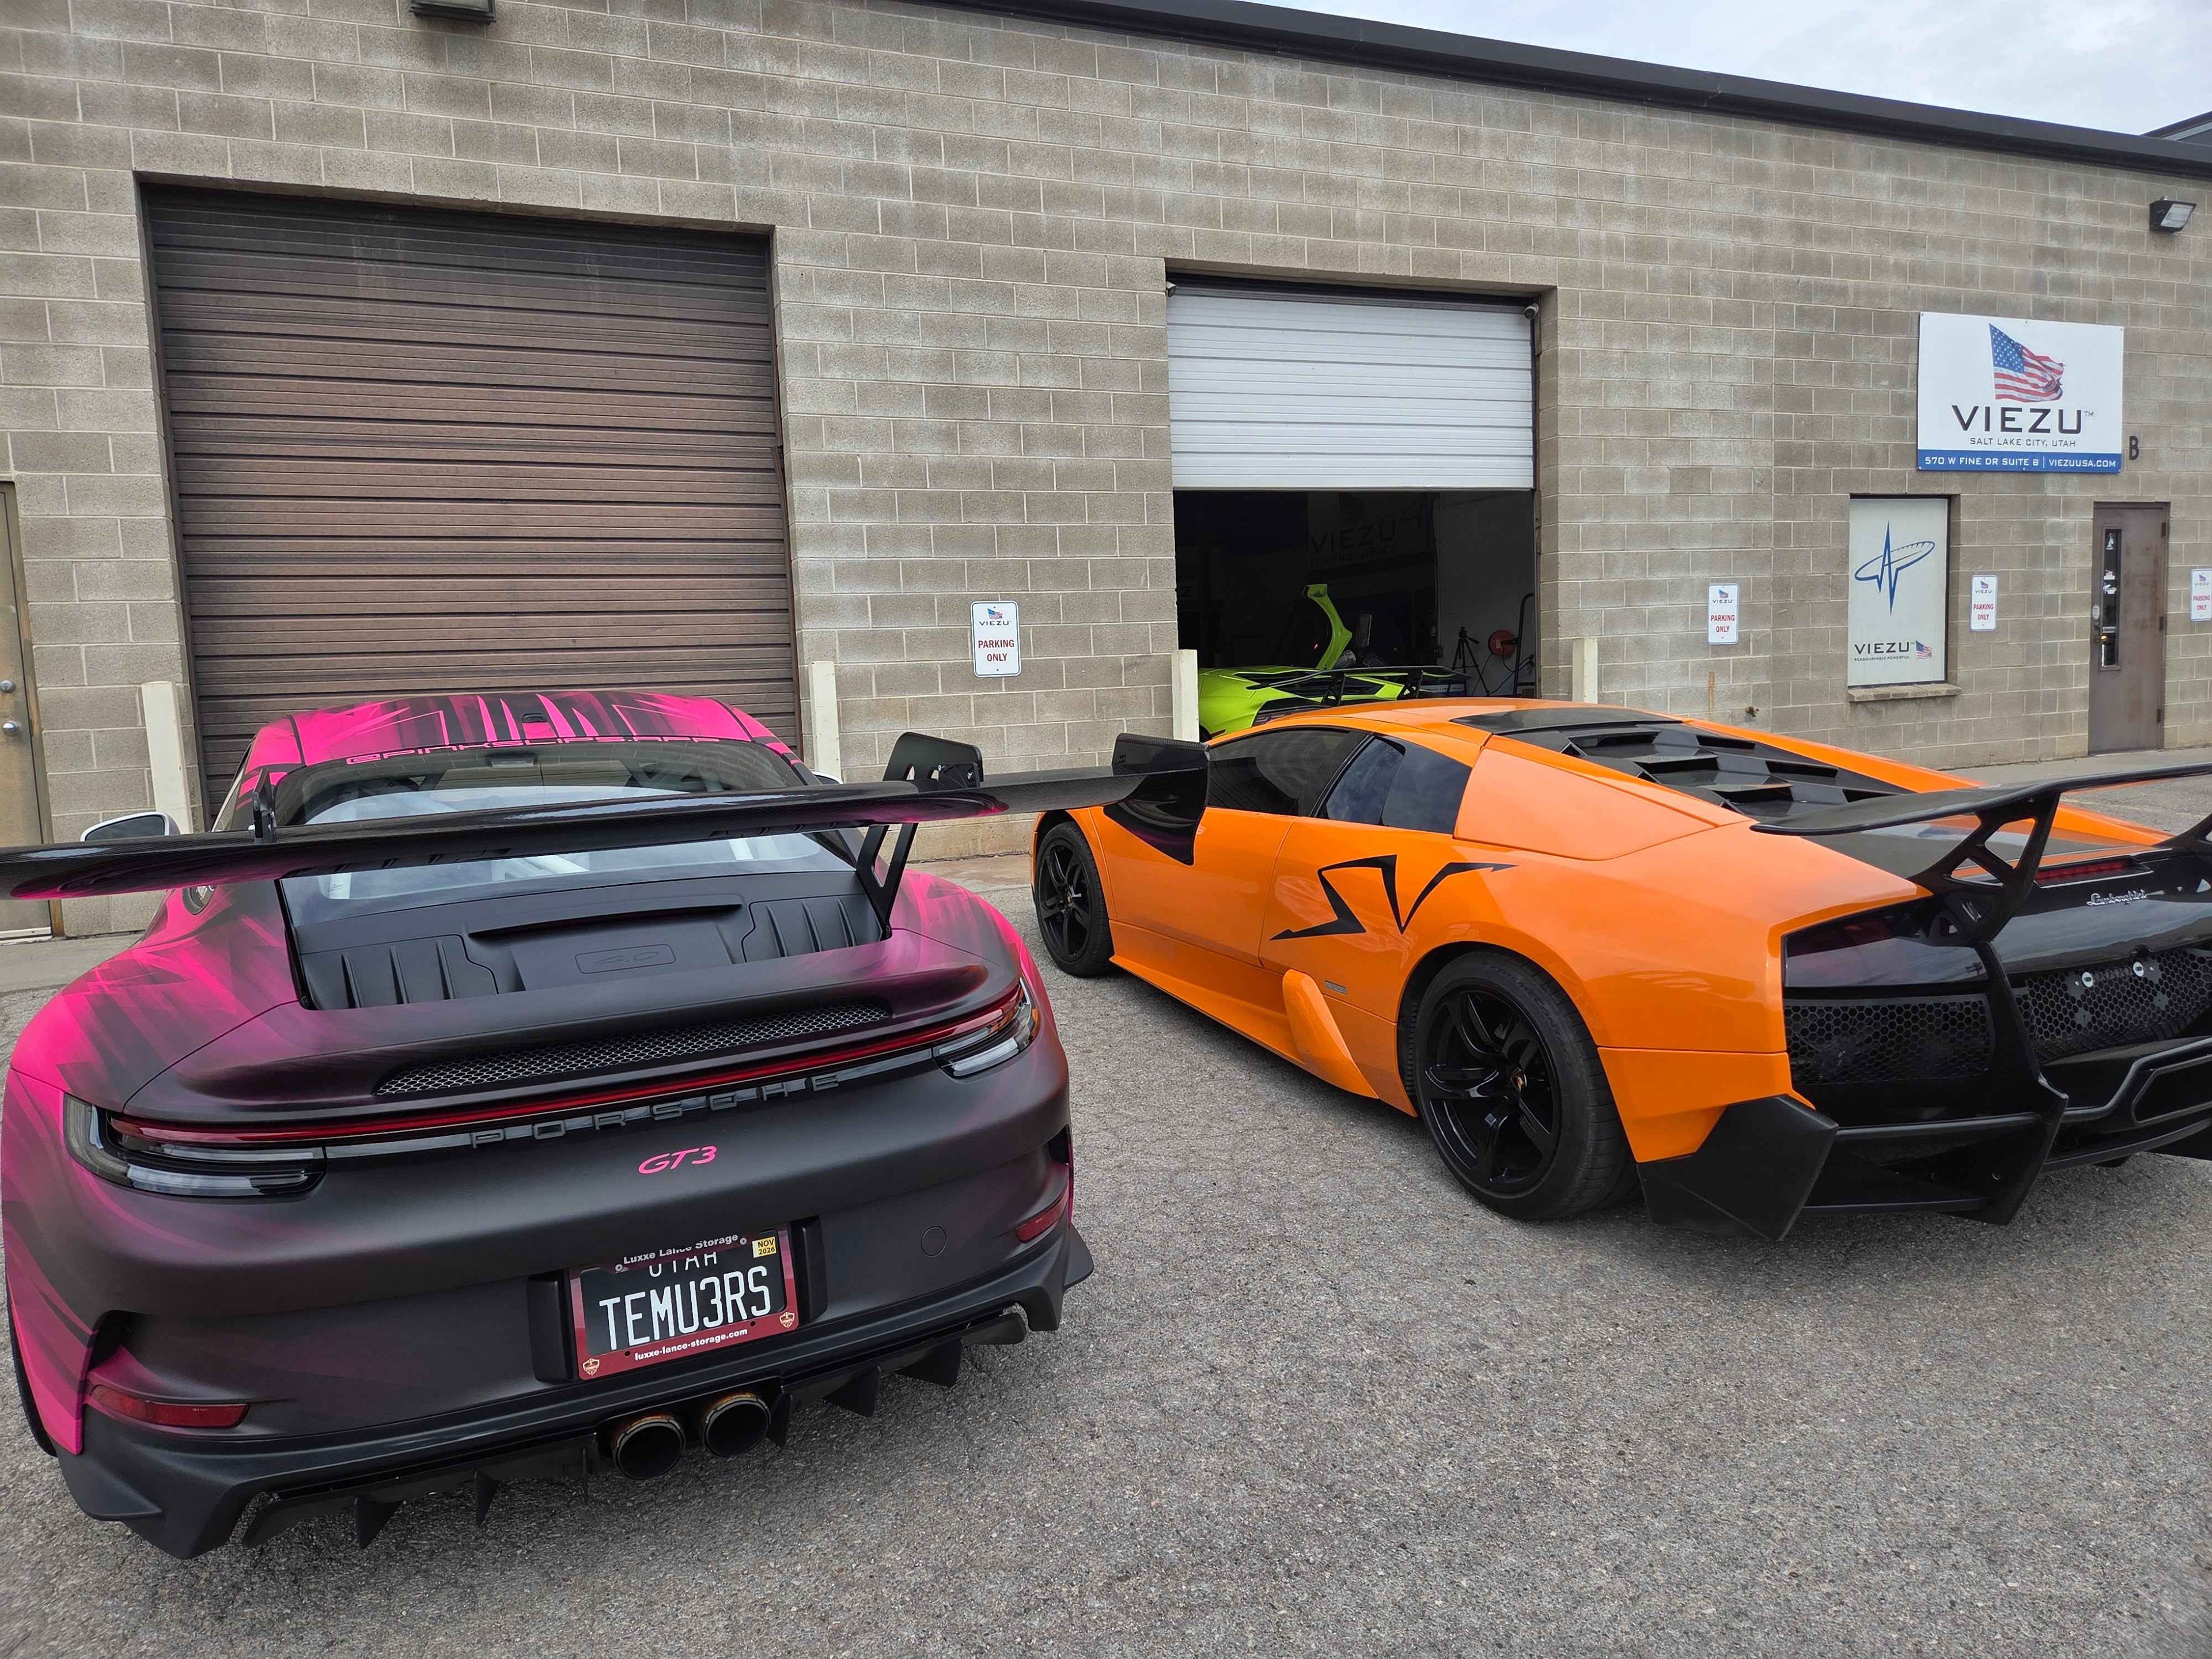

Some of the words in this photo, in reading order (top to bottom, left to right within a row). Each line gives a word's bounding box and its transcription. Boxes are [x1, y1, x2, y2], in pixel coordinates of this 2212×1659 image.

[1951, 404, 2082, 434] VIEZU
[2026, 439, 2048, 448] CITY,
[2129, 436, 2139, 460] B
[1925, 457, 1944, 465] 570
[2002, 458, 2029, 466] SUITE
[2049, 459, 2116, 467] VIEZUUSA.COM
[978, 639, 1014, 648] PARKING
[1854, 642, 1909, 654] VIEZU
[987, 653, 1007, 661] ONLY
[471, 1074, 838, 1148] PORSCHE
[638, 1146, 717, 1174] GT3
[623, 1252, 656, 1264] Luxxe
[695, 1234, 738, 1249] Storage
[757, 1238, 774, 1248] NOV
[758, 1247, 775, 1255] 2026
[599, 1266, 771, 1350] TEMU3RS
[635, 1328, 748, 1361] luxxe-lance-storage.com
